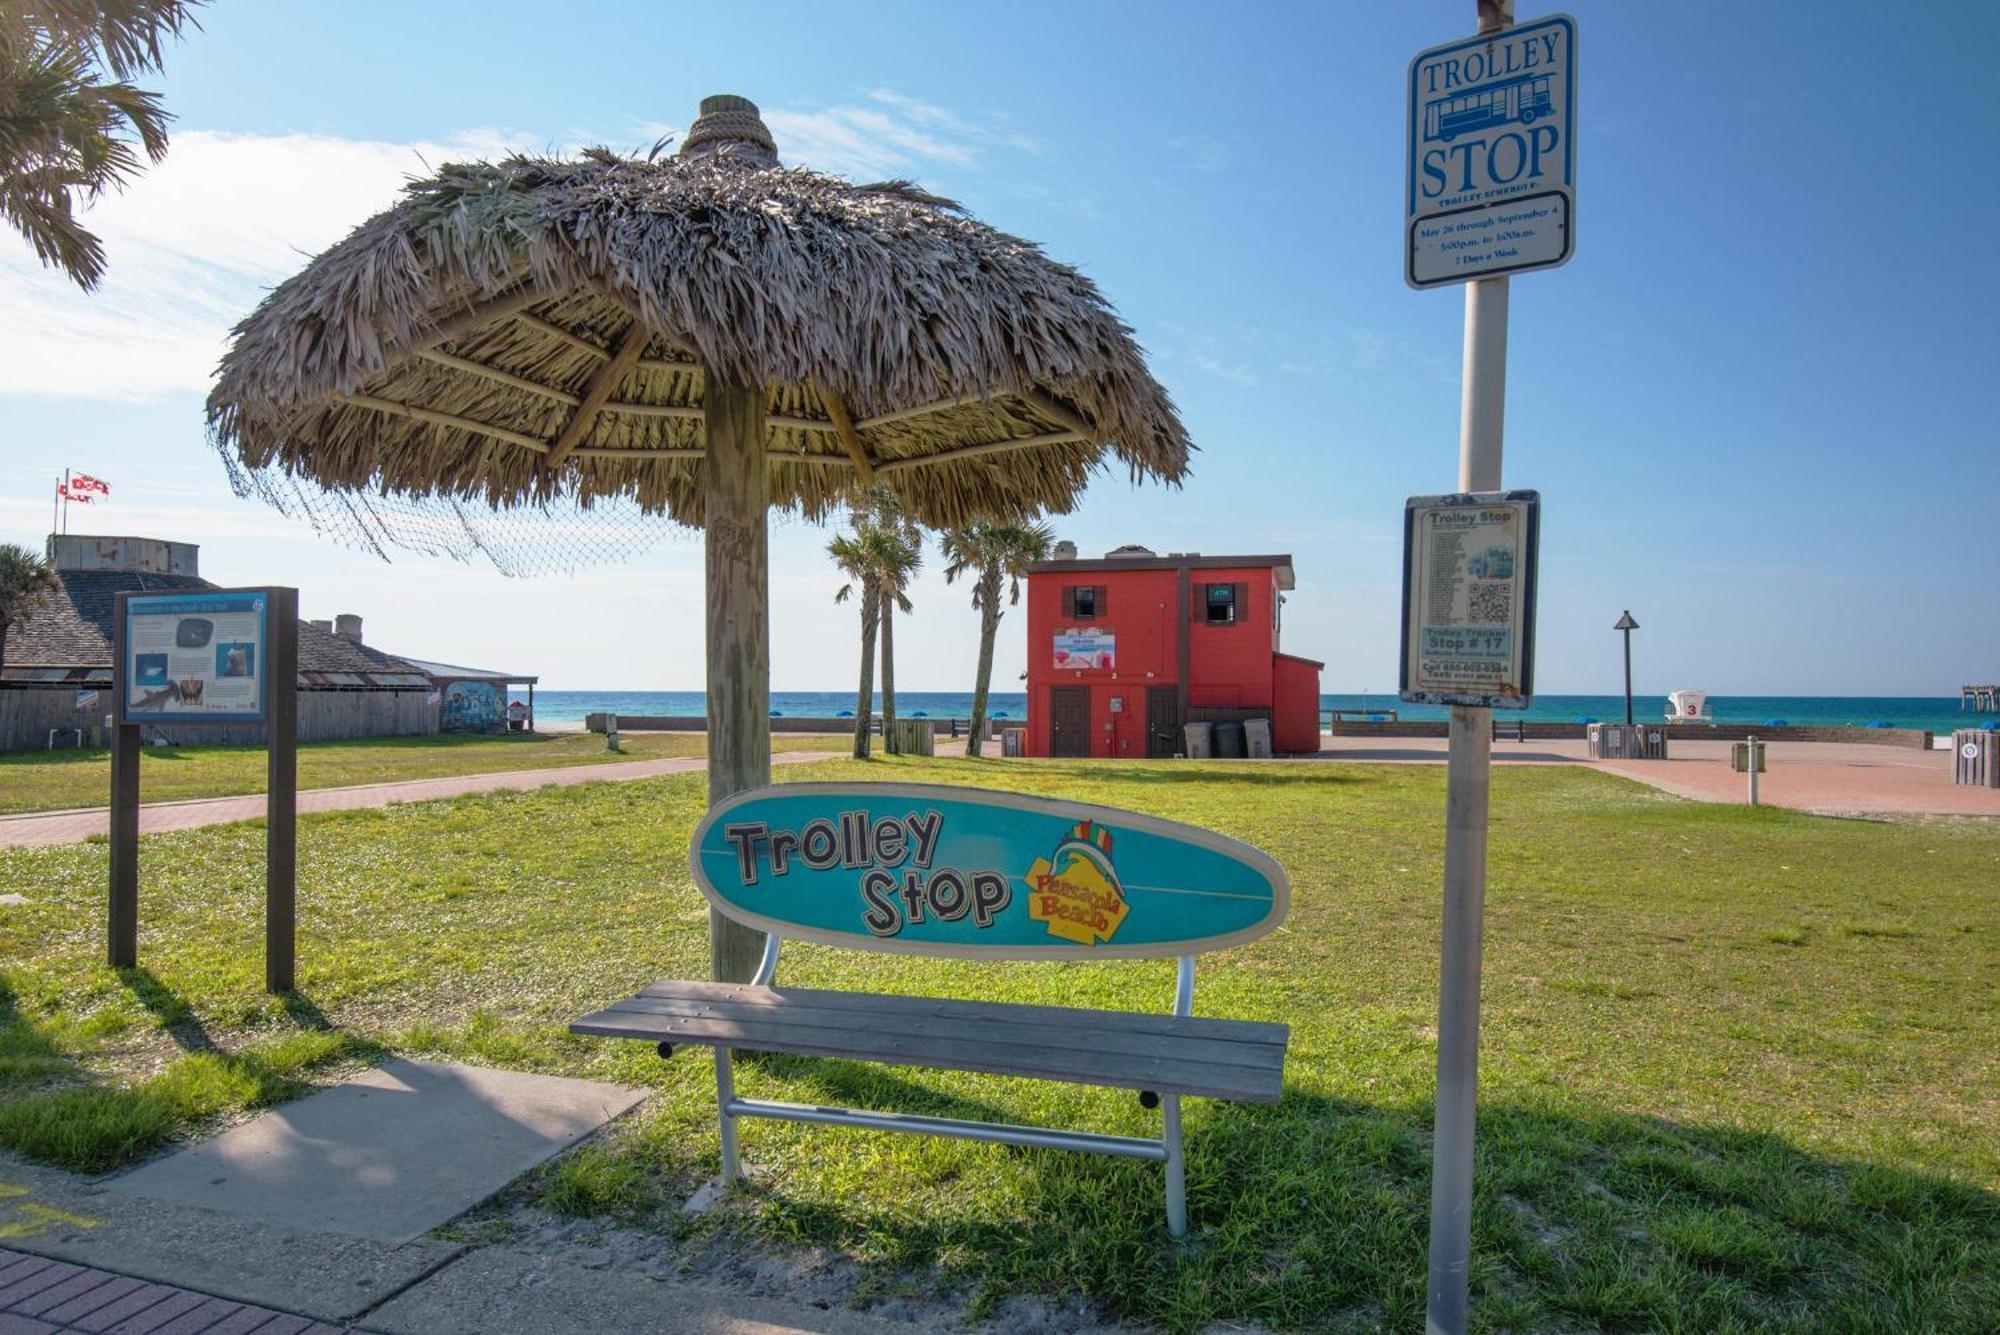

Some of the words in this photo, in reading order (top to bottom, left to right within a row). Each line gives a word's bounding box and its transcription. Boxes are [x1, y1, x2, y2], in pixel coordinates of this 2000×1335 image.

[1423, 31, 1560, 93] TROLLEY
[1421, 125, 1559, 198] STOP
[1438, 193, 1481, 207] TROLLEY
[1420, 228, 1440, 239] May
[1456, 217, 1494, 234] through
[1497, 209, 1549, 224] September
[1482, 235, 1493, 244] to
[1463, 254, 1484, 264] Days
[1495, 247, 1519, 258] Week
[1430, 512, 1475, 526] Trolley
[1480, 510, 1511, 523] Stop
[1430, 637, 1464, 650] Stop
[1469, 639, 1479, 648] #
[1484, 638, 1502, 649] 17
[1687, 704, 1697, 716] 3
[725, 809, 943, 885] Trolley
[860, 867, 1012, 937] Stop
[1035, 873, 1121, 915] Pensacola
[1039, 896, 1109, 932] Beach
